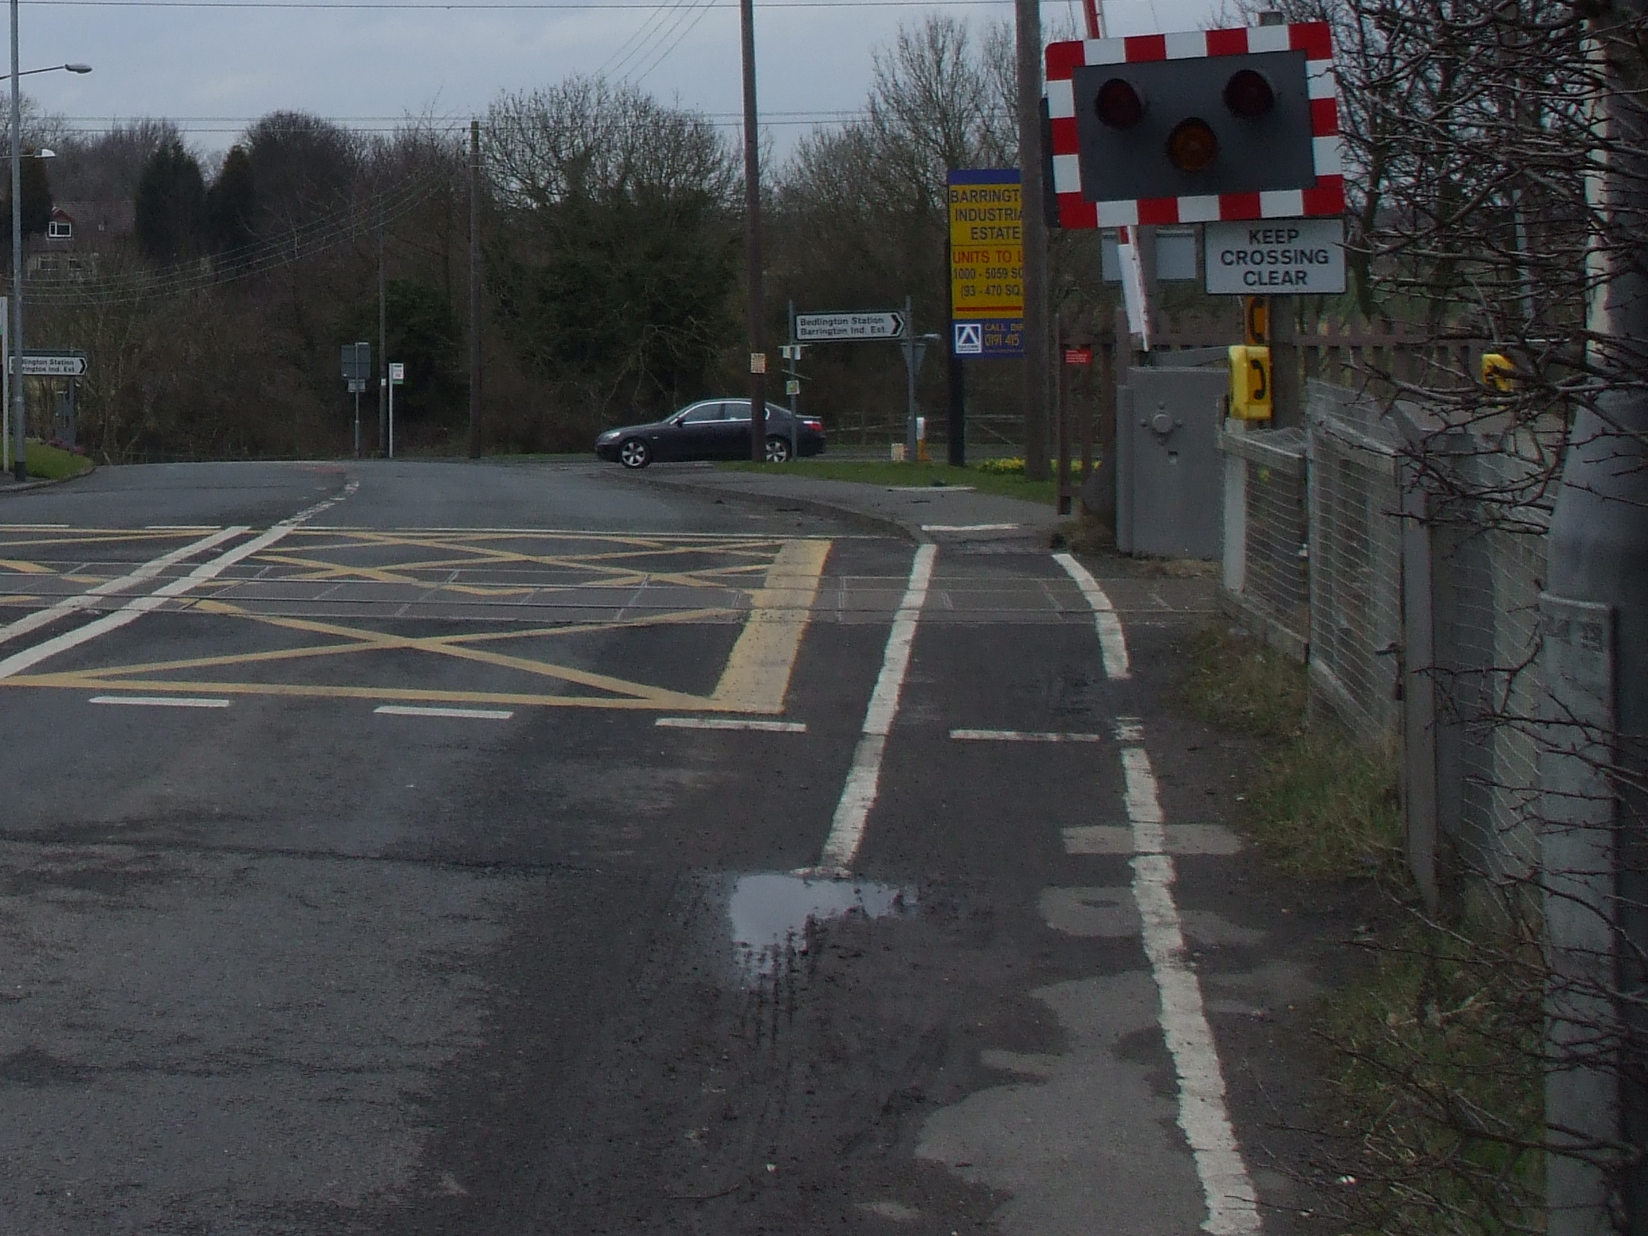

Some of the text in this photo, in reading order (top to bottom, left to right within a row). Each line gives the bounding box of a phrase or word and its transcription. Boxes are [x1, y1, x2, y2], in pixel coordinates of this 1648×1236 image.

[950, 189, 1021, 203] BARRINGT
[970, 226, 1021, 240] ESTATE
[1249, 229, 1300, 245] KEEP
[953, 250, 1023, 264] UNITS TO L
[1220, 249, 1329, 265] CROSSING
[955, 268, 975, 280] 1000
[1243, 270, 1308, 286] CLEAR
[800, 316, 884, 327] Bedlington Station
[800, 327, 847, 336] Barrington
